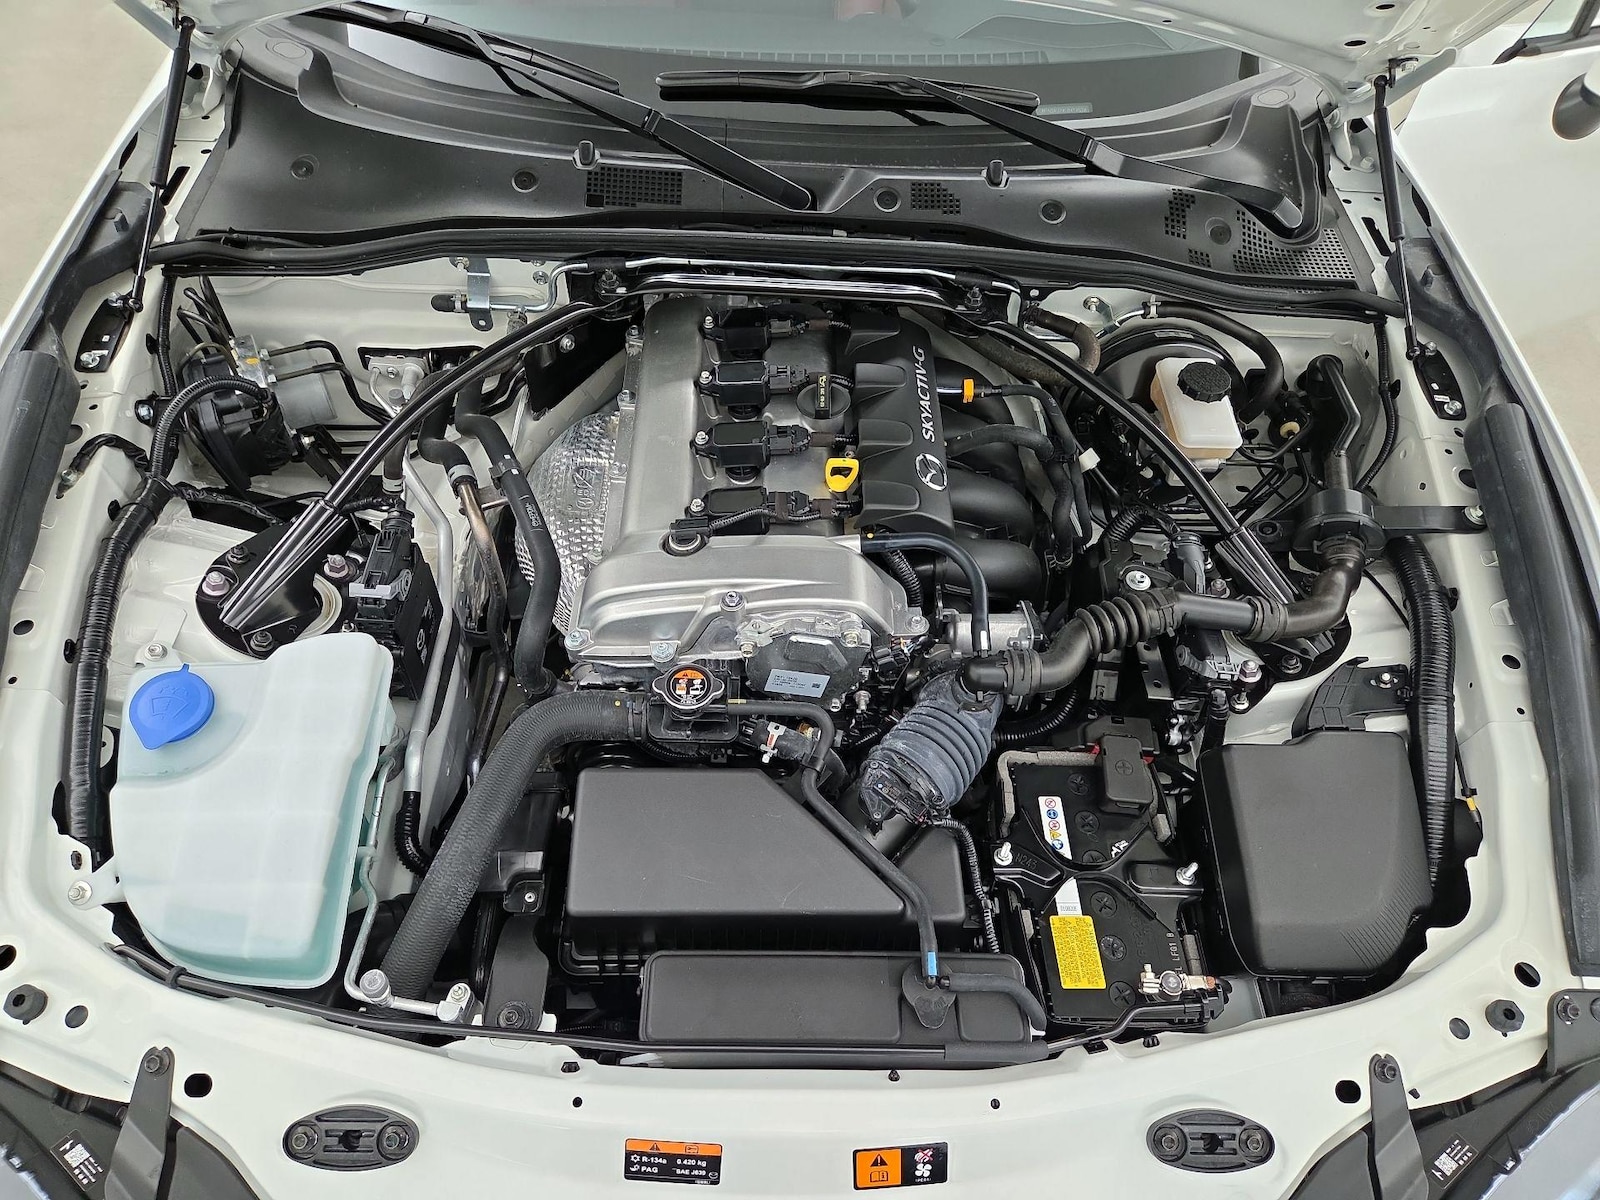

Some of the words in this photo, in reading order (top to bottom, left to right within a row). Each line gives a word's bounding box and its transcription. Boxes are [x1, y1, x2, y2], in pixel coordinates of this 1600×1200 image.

[912, 345, 935, 443] SKYACTIV-G
[641, 1156, 667, 1164] R-134a
[676, 1158, 696, 1166] 0.420
[697, 1159, 707, 1167] kg
[641, 1165, 659, 1173] PAG
